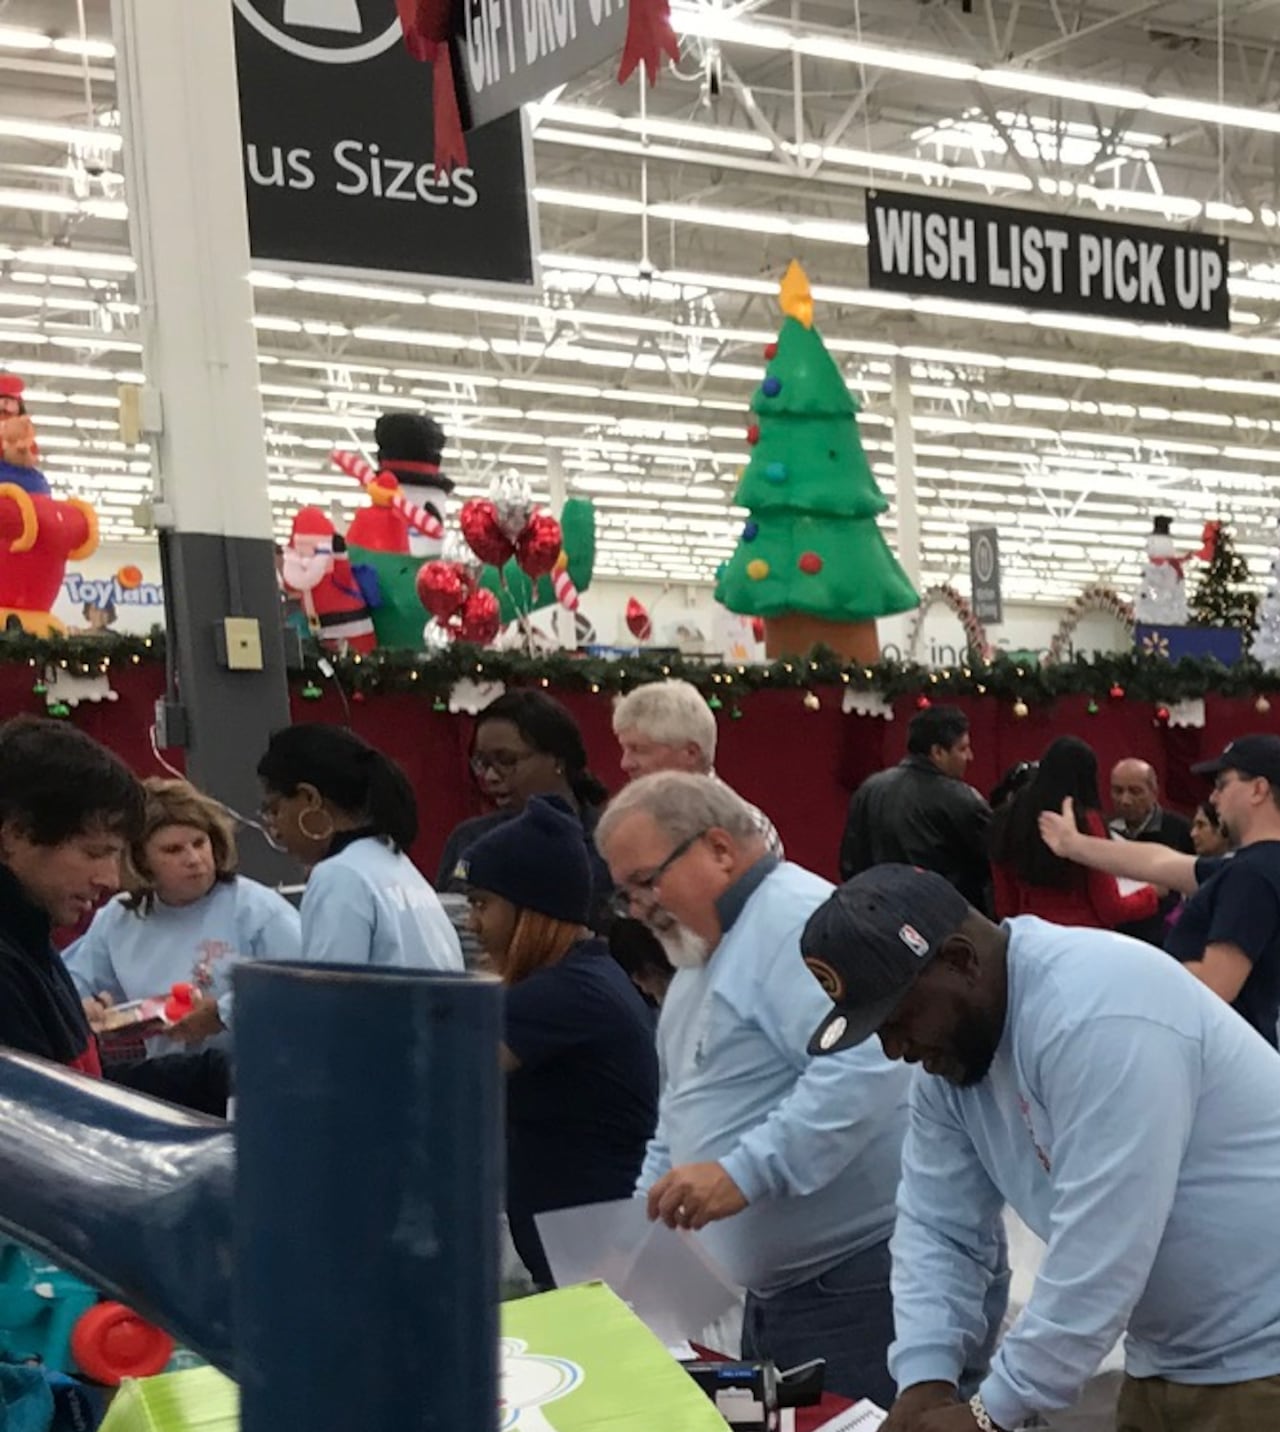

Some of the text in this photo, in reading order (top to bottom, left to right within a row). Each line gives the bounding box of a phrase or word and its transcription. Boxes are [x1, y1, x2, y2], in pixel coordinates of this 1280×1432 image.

[332, 139, 479, 208] Sizes
[875, 205, 1224, 313] WISH LIST PICK UP
[65, 572, 165, 610] Toylan
